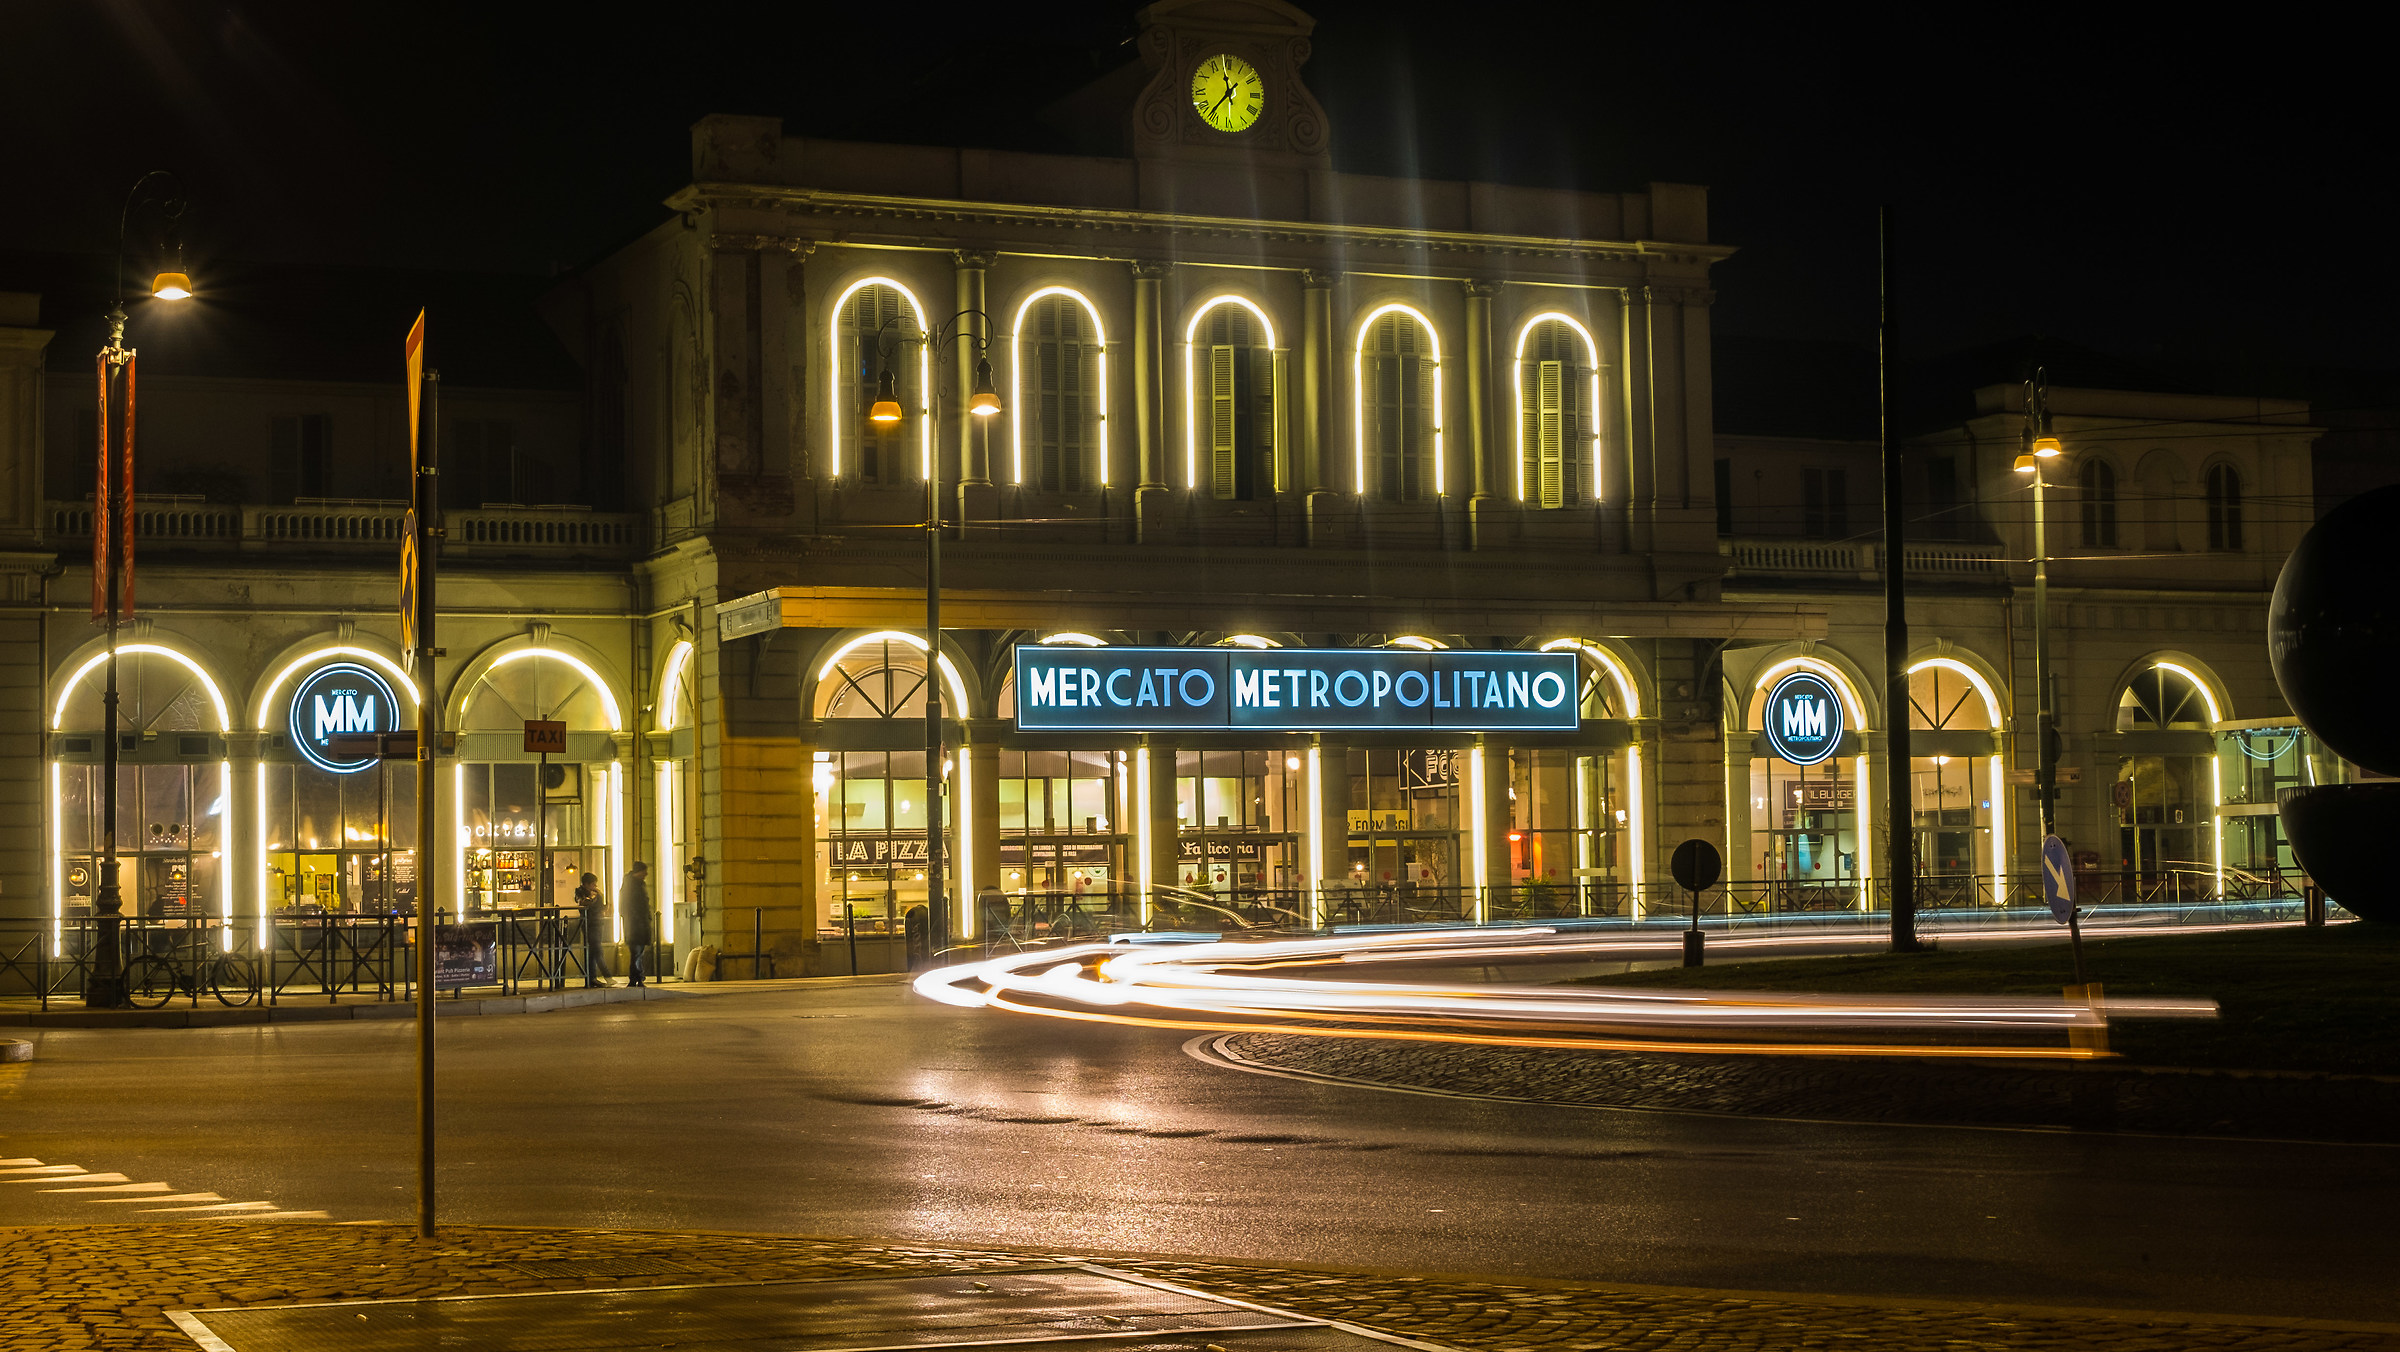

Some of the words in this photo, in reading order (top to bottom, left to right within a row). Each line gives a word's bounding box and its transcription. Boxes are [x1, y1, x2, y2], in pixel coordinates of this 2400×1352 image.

[1030, 667, 1215, 707] MERCATO
[1235, 669, 1566, 709] METROPOLITANO
[314, 694, 375, 740] MM
[528, 729, 563, 744] TAXI
[1783, 698, 1826, 737] MM
[837, 840, 868, 860] LA
